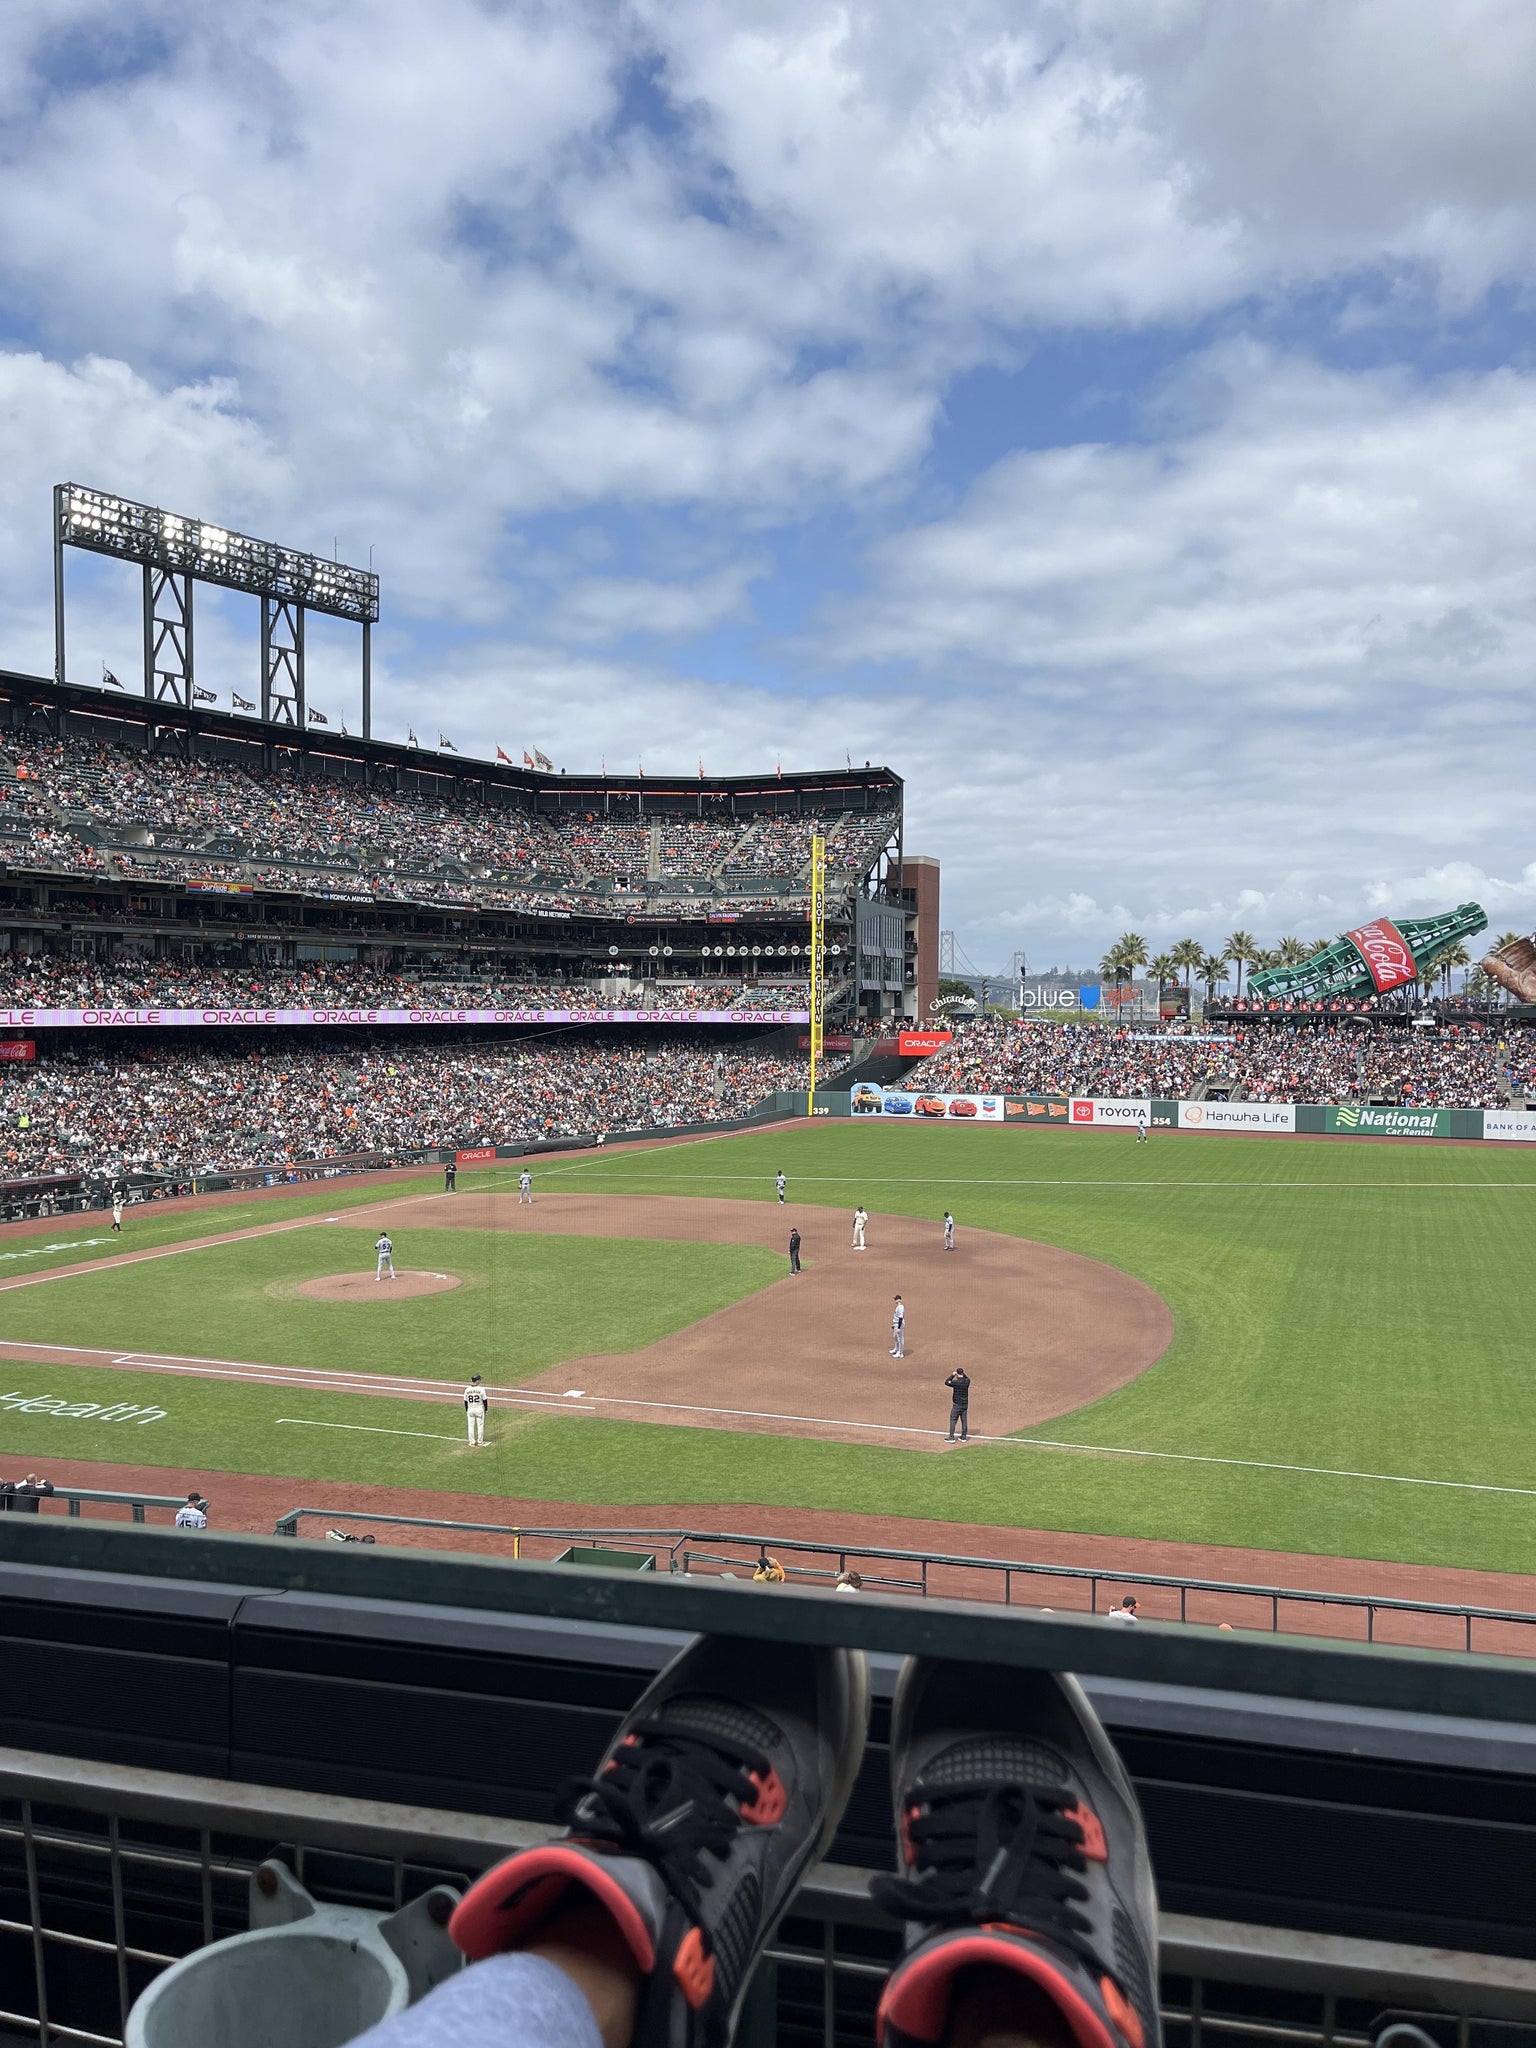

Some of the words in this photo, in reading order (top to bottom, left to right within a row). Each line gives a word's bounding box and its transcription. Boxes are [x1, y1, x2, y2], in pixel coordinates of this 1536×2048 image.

[330, 893, 350, 901] KONICA
[351, 895, 375, 903] MINOLTA
[549, 911, 571, 919] NETWORK
[1020, 985, 1075, 1007] blue
[83, 1011, 160, 1024] ORACLE
[203, 1011, 276, 1023] ORACLE
[313, 1011, 377, 1023] ORACLE
[409, 1012, 466, 1022] ORACLE
[494, 1012, 545, 1022] ORACLE
[569, 1011, 614, 1021] ORACLE
[637, 1012, 697, 1021] ORACLE
[731, 1012, 790, 1022] ORACLE
[904, 1040, 946, 1048] ORACLE
[813, 1107, 829, 1115] 339
[1098, 1107, 1147, 1118] TOYOTA
[1152, 1117, 1171, 1125] 354
[1206, 1110, 1260, 1122] Hanwha
[1263, 1113, 1289, 1124] Life
[1386, 1127, 1402, 1136] Car
[1403, 1128, 1434, 1137] Rental
[461, 1150, 491, 1160] ORACLE
[468, 1395, 480, 1403] 82
[0, 1391, 168, 1424] Health
